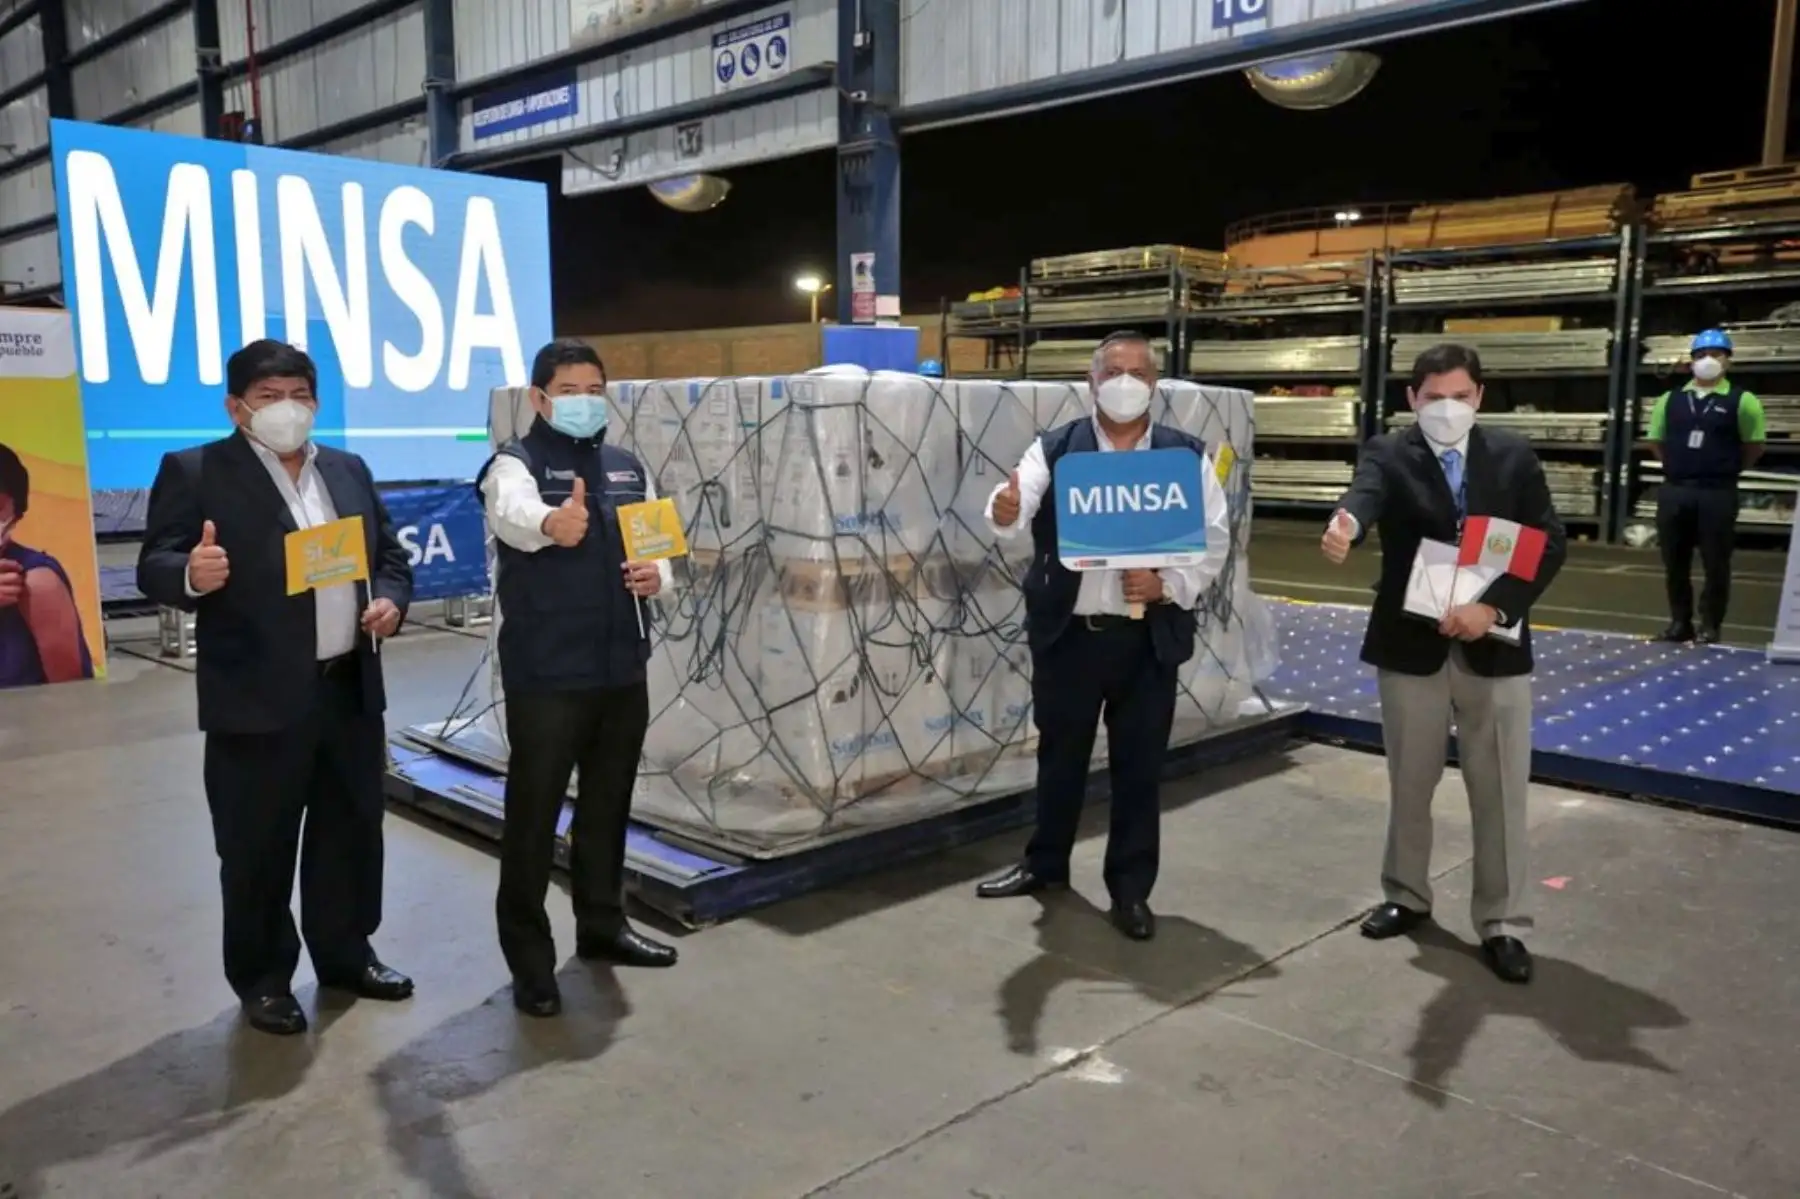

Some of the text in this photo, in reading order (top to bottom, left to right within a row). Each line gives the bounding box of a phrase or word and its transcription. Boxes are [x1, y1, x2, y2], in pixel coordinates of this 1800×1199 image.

[66, 150, 527, 391] MINSA
[1068, 482, 1188, 514] MINSA
[397, 523, 456, 566] SA
